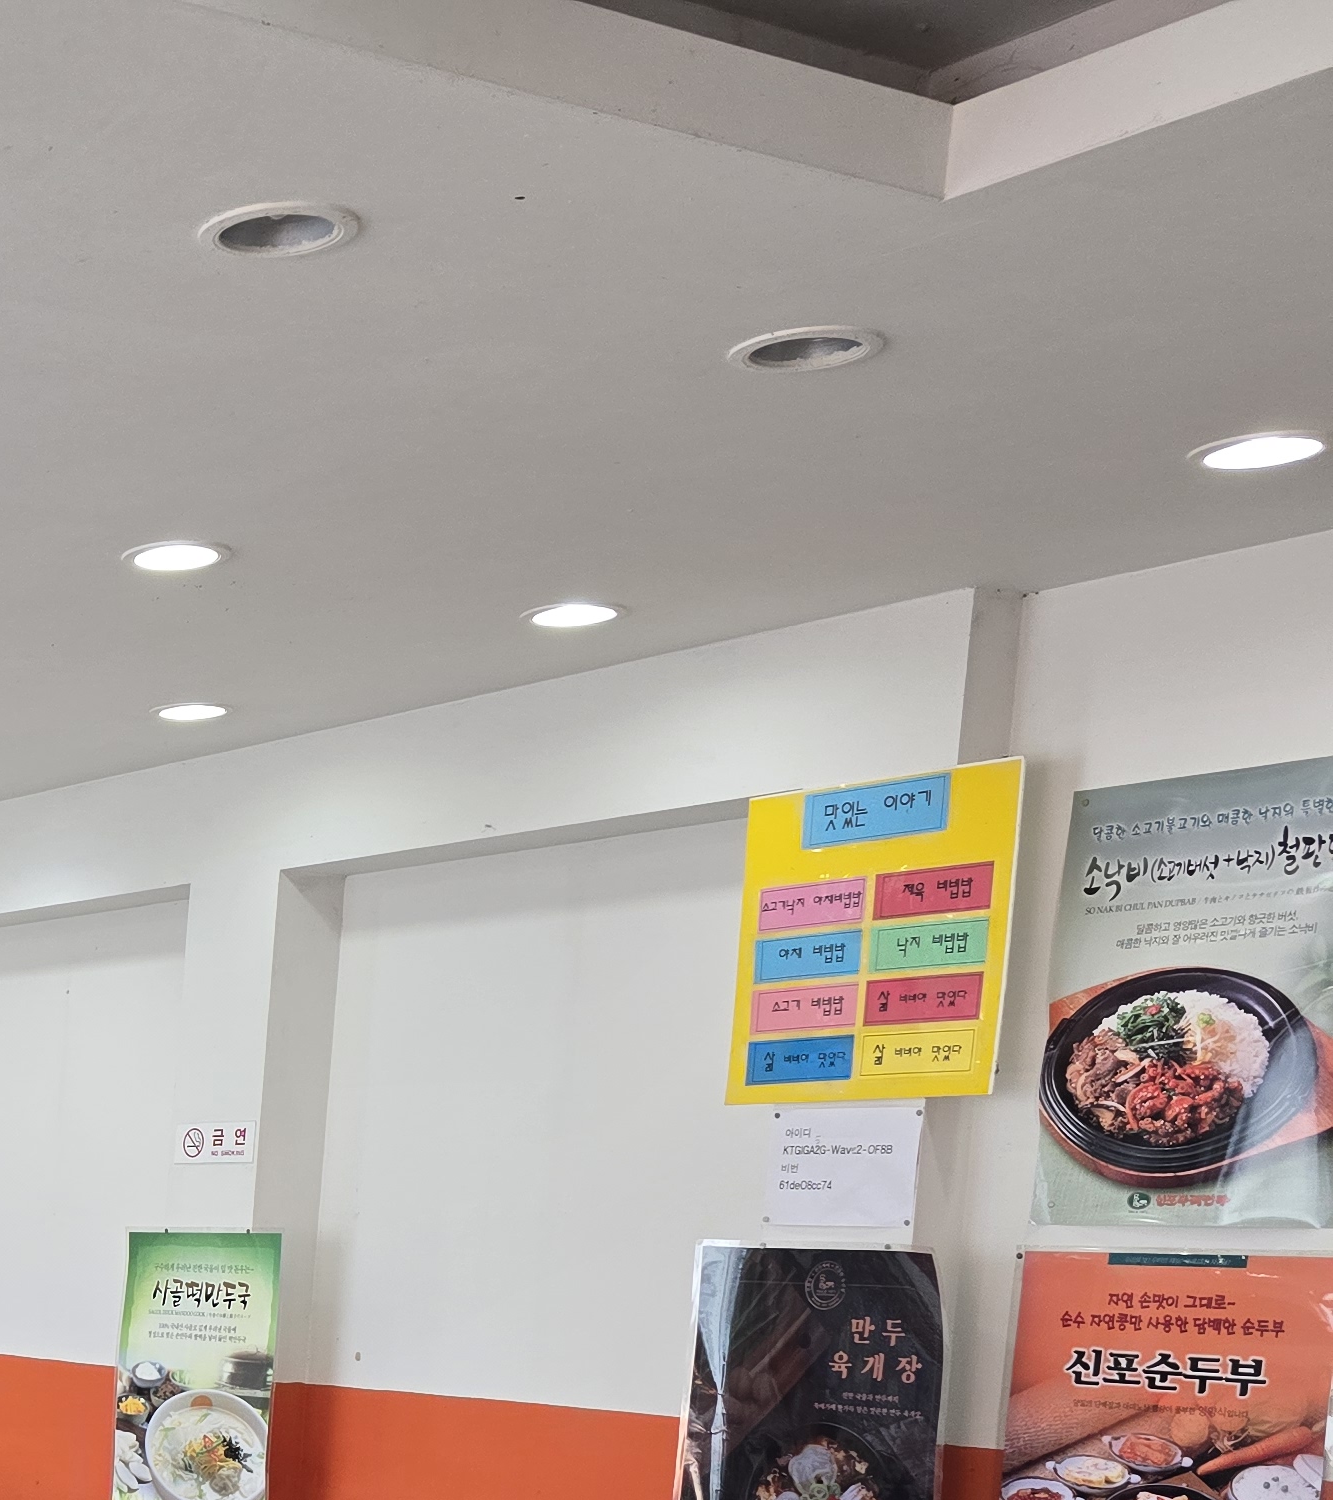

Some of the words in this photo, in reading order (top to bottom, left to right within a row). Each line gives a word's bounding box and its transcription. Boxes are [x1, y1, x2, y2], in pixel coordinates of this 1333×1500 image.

[824, 802, 869, 831] 맛있는
[884, 789, 933, 811] 이야기
[1093, 824, 1126, 841] 달콤한
[1131, 814, 1213, 836] 소고기불고기와
[1217, 808, 1253, 824] 매콤한
[1259, 803, 1295, 821] 낙지의
[902, 882, 925, 902] 제육
[937, 877, 973, 899] 비빔밥
[762, 898, 805, 915] 소고기낙지
[813, 891, 862, 909] 야채비빔밥
[1085, 906, 1096, 915] SO
[1210, 915, 1246, 927] 소고기와
[897, 936, 921, 957] 낙지
[932, 932, 969, 953] 비빔밥
[1144, 935, 1169, 947] 낙지와
[1172, 934, 1181, 945] 잘
[1183, 930, 1218, 943] 어우러진
[1258, 925, 1286, 937] 즐기는
[779, 947, 802, 960] 야채
[813, 943, 846, 964] 비빔밥
[772, 1000, 800, 1012] 소고기
[811, 996, 844, 1017] 비빔밥
[936, 990, 967, 1008] 맛있다
[818, 1051, 846, 1068] 맛있다
[931, 1044, 962, 1062] 맛있다
[785, 1128, 811, 1138] 아이디
[781, 1163, 799, 1173] 비번
[152, 1278, 251, 1310] 사골떡만두국
[1108, 1292, 1134, 1307] 자연
[1138, 1294, 1179, 1310] 손맛이
[1060, 1312, 1086, 1329] 순수
[1090, 1312, 1143, 1332] 자연콩만
[1147, 1316, 1189, 1334] 사용한
[1193, 1319, 1236, 1336] 담백한
[1241, 1319, 1285, 1338] 순두부
[1065, 1348, 1267, 1397] 신포순두부
